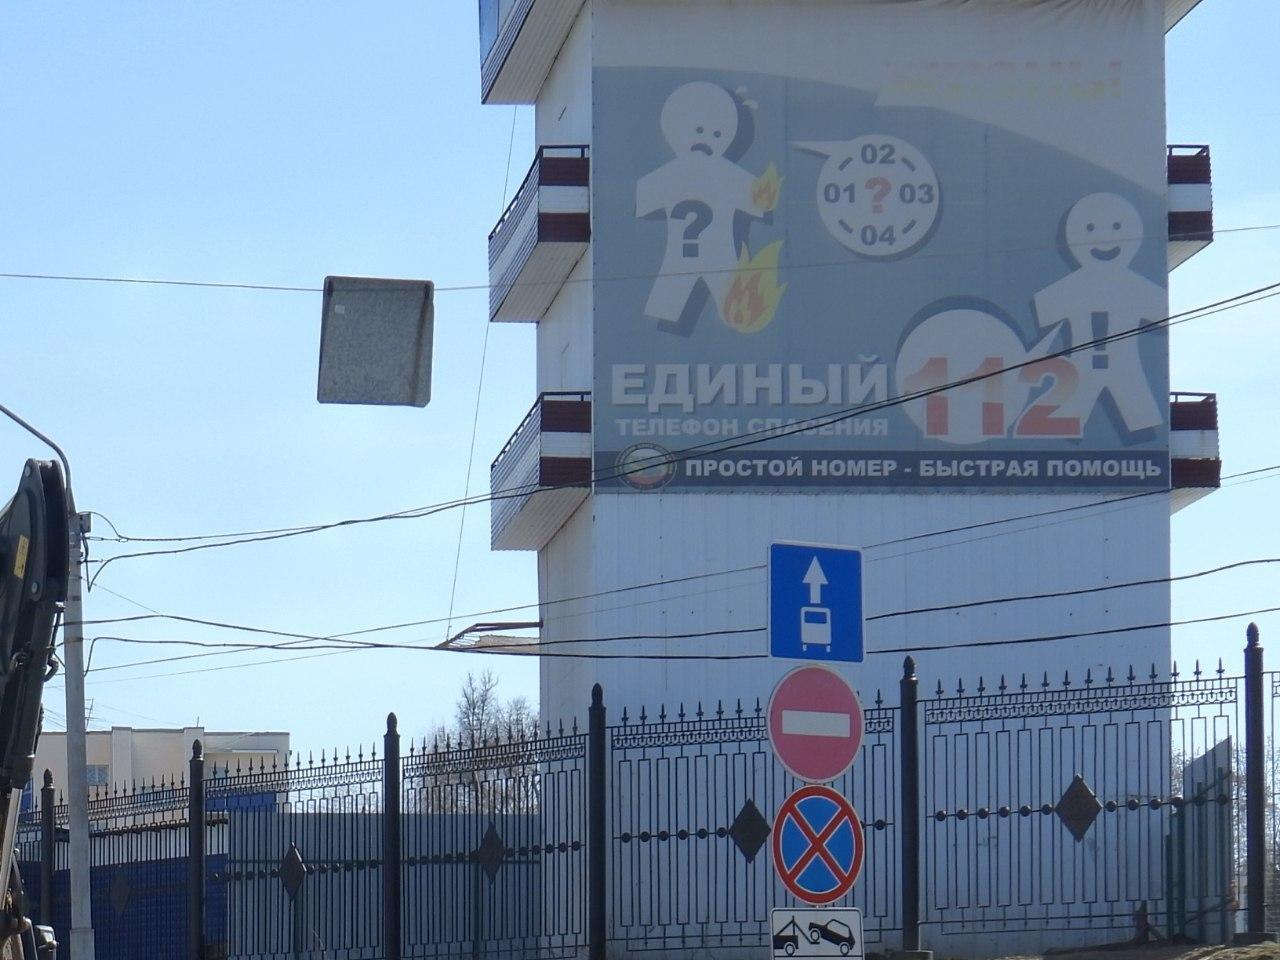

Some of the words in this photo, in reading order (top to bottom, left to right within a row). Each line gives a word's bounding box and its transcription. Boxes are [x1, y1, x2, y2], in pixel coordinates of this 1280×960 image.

[861, 143, 896, 165] 02
[824, 183, 855, 203] 01
[900, 183, 934, 204] 03
[861, 224, 896, 246] 04
[611, 354, 889, 413] ЕДИНЫЙ
[904, 356, 1082, 437] 112
[616, 418, 738, 436] ТЕЛЕФОН
[747, 418, 889, 436] СПАСЕНИЯ
[686, 456, 803, 477] ПРОСТОЙ
[812, 460, 897, 476] НОМЕР
[920, 460, 1040, 477] БЫСТРАЯ
[1047, 460, 1162, 479] ПОМОЩЬ
